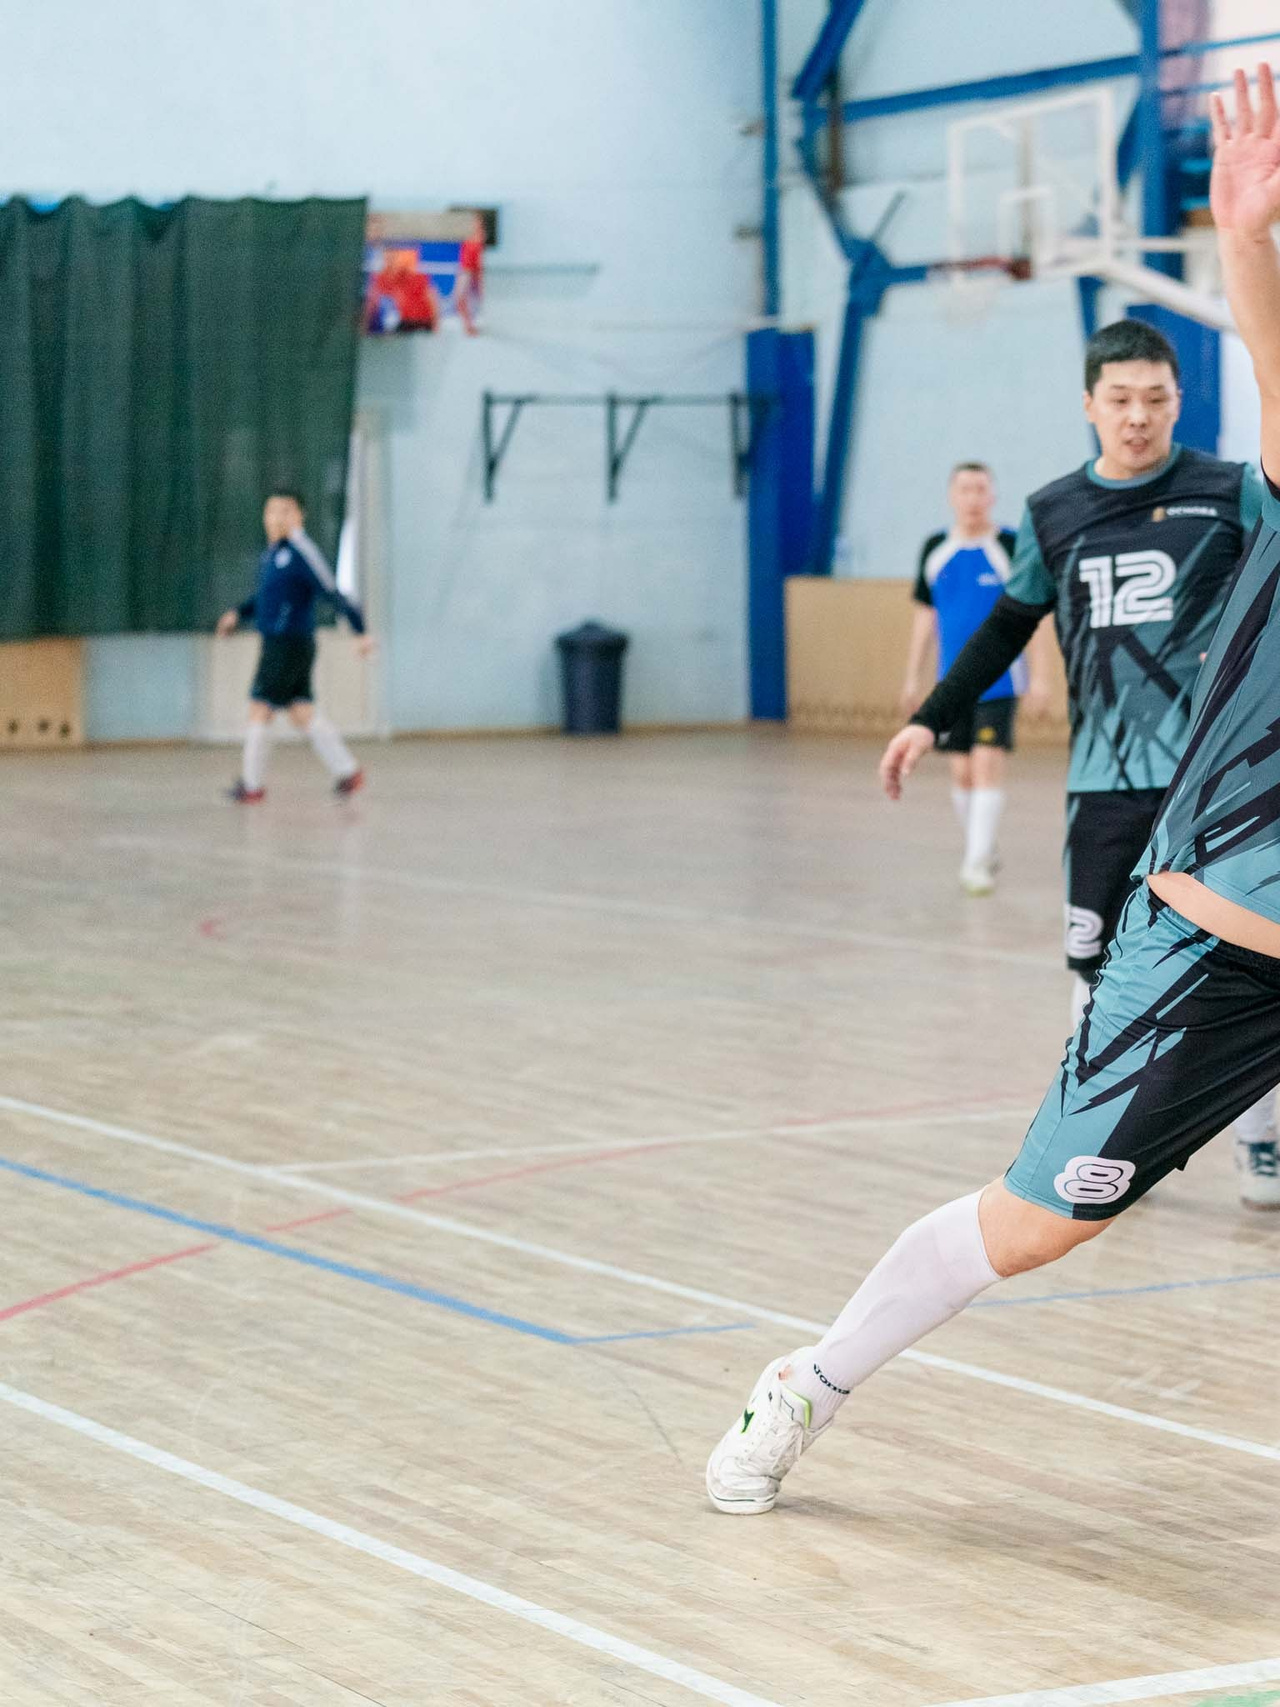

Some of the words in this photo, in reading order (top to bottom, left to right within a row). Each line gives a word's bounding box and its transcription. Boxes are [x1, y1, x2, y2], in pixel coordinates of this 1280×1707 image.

[1079, 549, 1177, 629] 12
[1065, 905, 1104, 959] 2
[1054, 1155, 1136, 1204] 8
